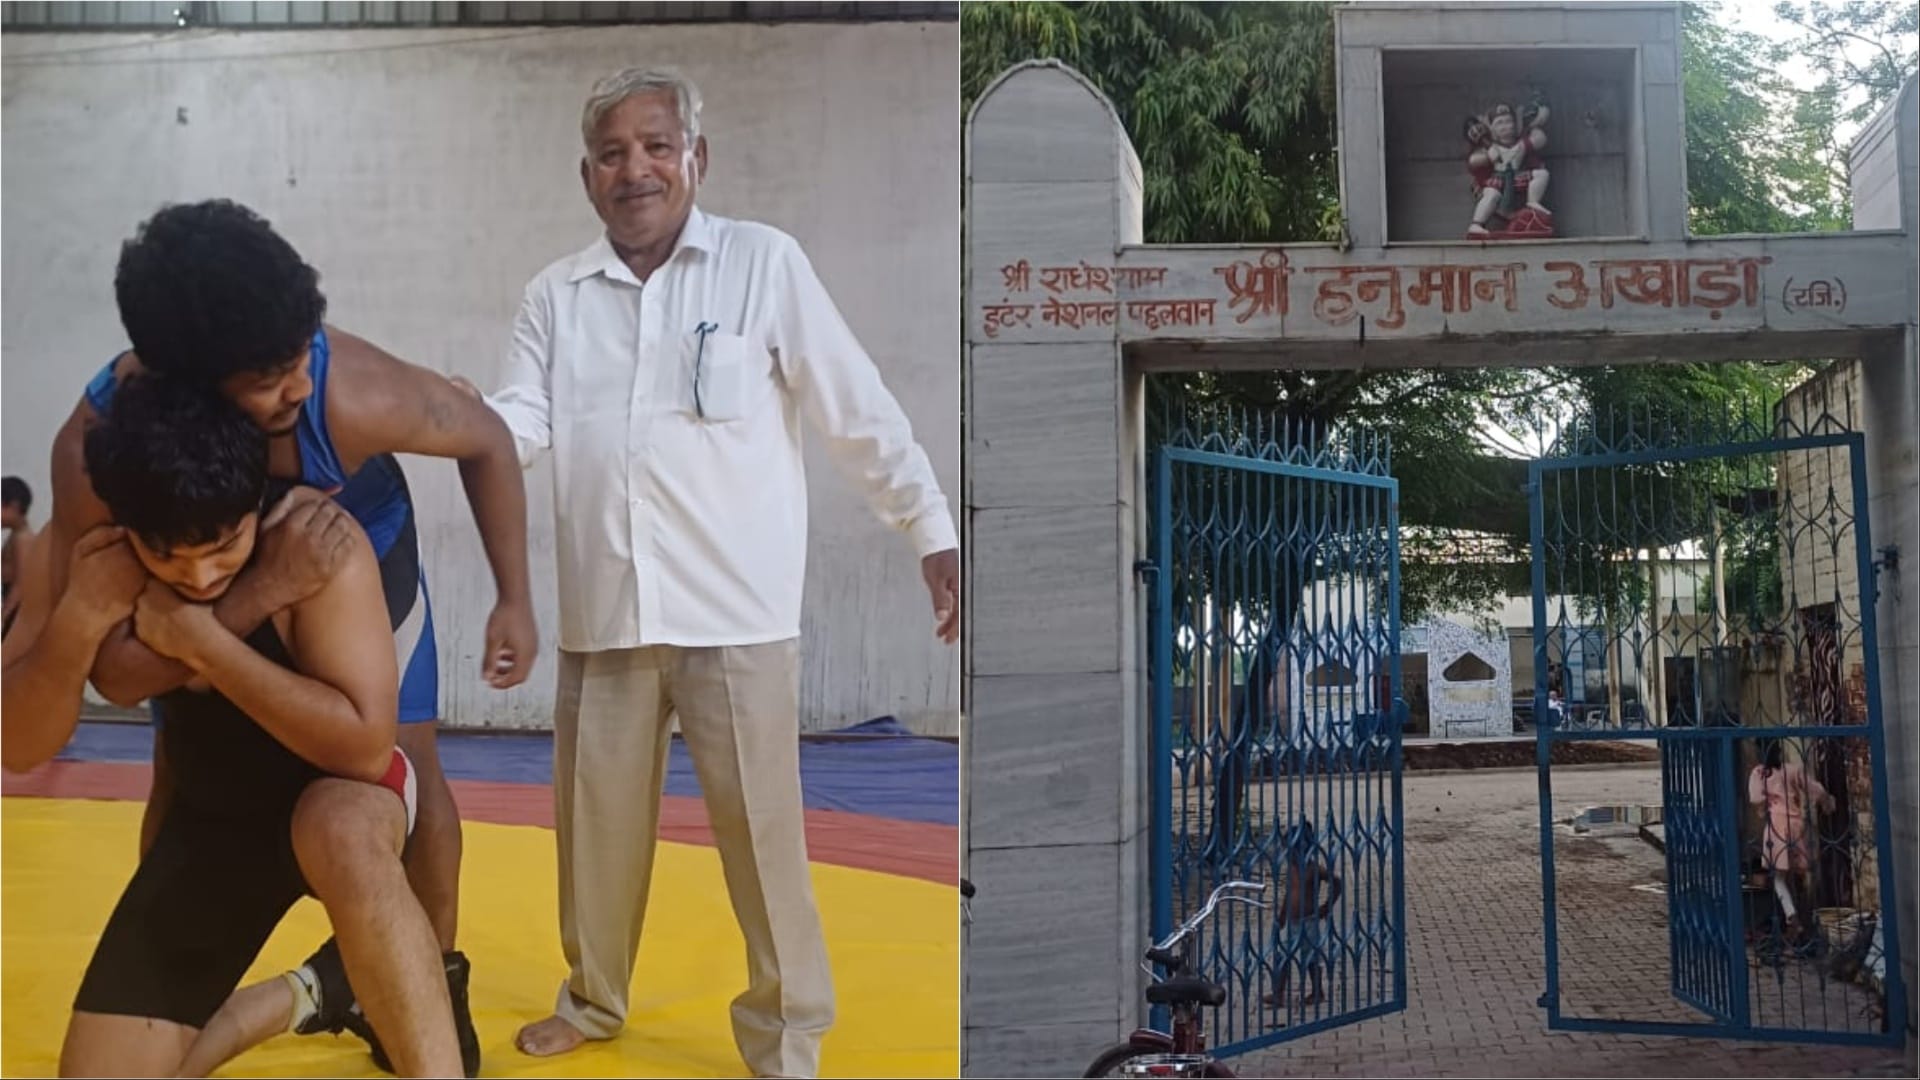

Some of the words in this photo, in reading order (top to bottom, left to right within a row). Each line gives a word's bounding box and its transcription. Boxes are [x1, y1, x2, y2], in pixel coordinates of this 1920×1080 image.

[1001, 259, 1031, 292] श्री
[1213, 248, 1295, 324] श्री
[1304, 262, 1527, 329] हनुमान
[1544, 256, 1773, 320] अखाड़ा
[982, 297, 1035, 338] इंटर
[1042, 296, 1119, 330] नेशनल
[1128, 298, 1217, 330] पहलवान
